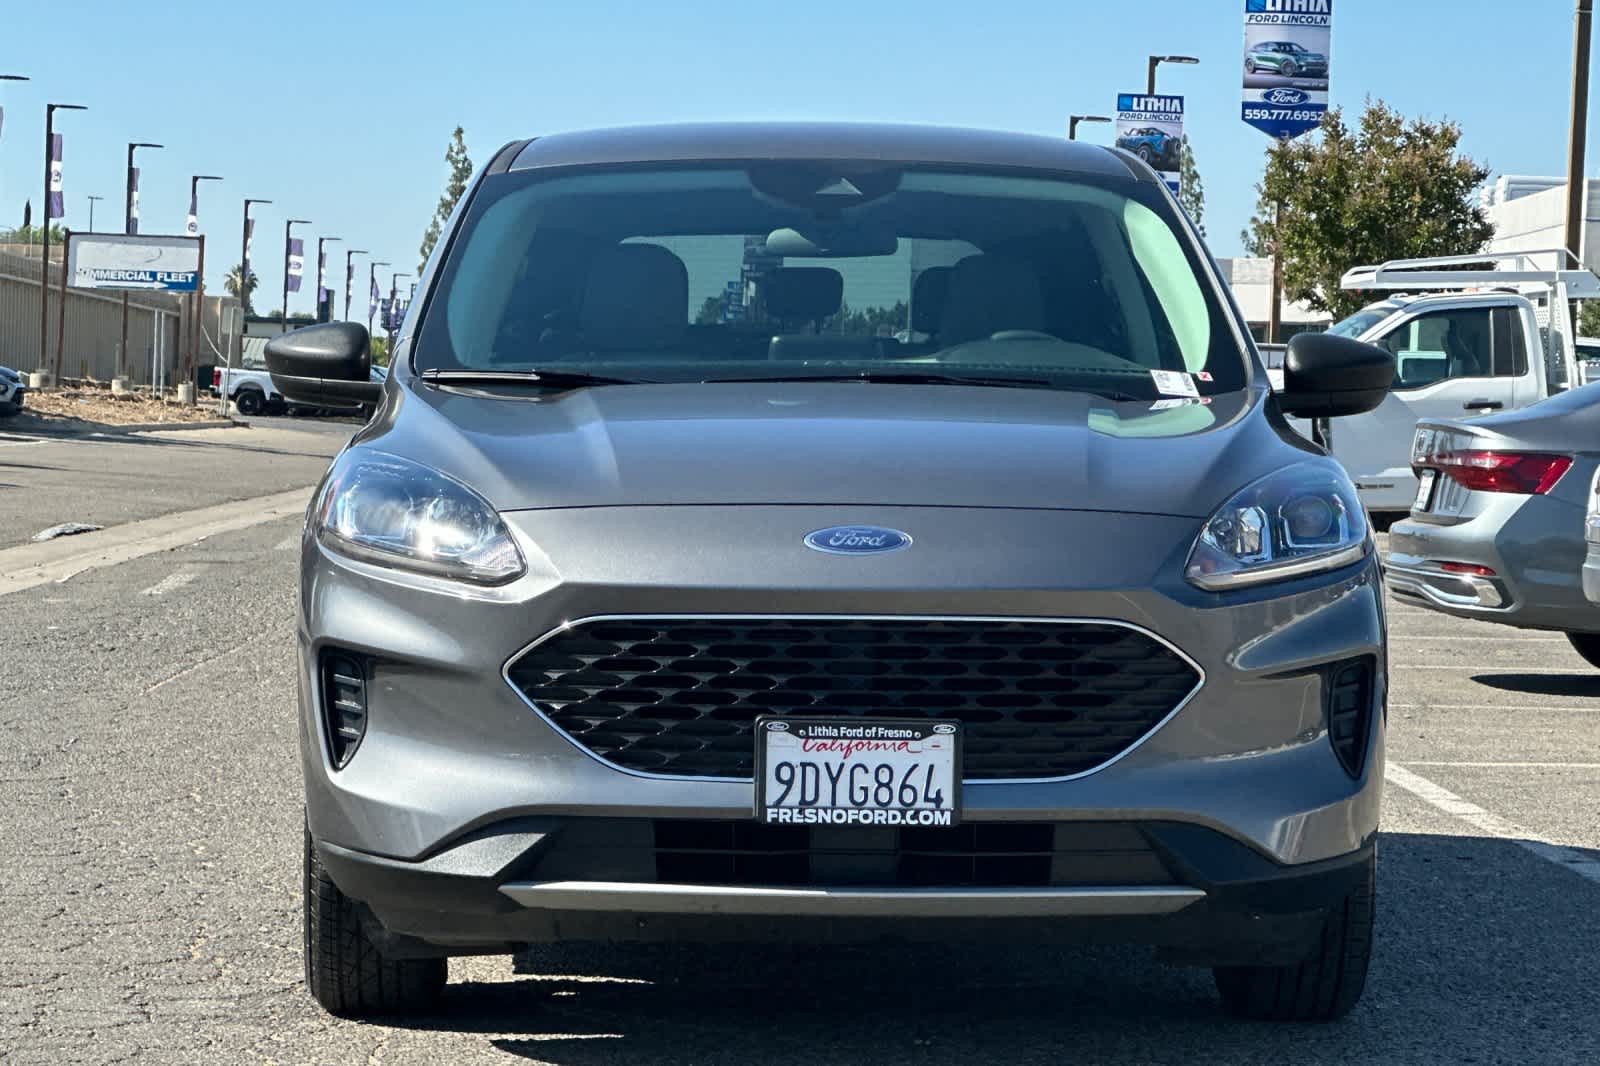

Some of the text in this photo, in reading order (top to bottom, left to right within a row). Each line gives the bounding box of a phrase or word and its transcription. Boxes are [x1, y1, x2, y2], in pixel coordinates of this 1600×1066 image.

[1266, 0, 1329, 13] LITHIA
[1248, 14, 1328, 25] FORD LINCOLN
[1270, 89, 1301, 104] Ford
[1133, 97, 1181, 112] LITHIA
[1120, 112, 1181, 121] FORD LINCOLN
[157, 272, 194, 282] FLEET
[829, 529, 887, 547] Ford
[808, 726, 912, 739] Lithia Ford of Fresno
[802, 737, 922, 759] California
[774, 761, 943, 808] 9DYG864
[766, 808, 951, 826] FRESNOFORD.COM
